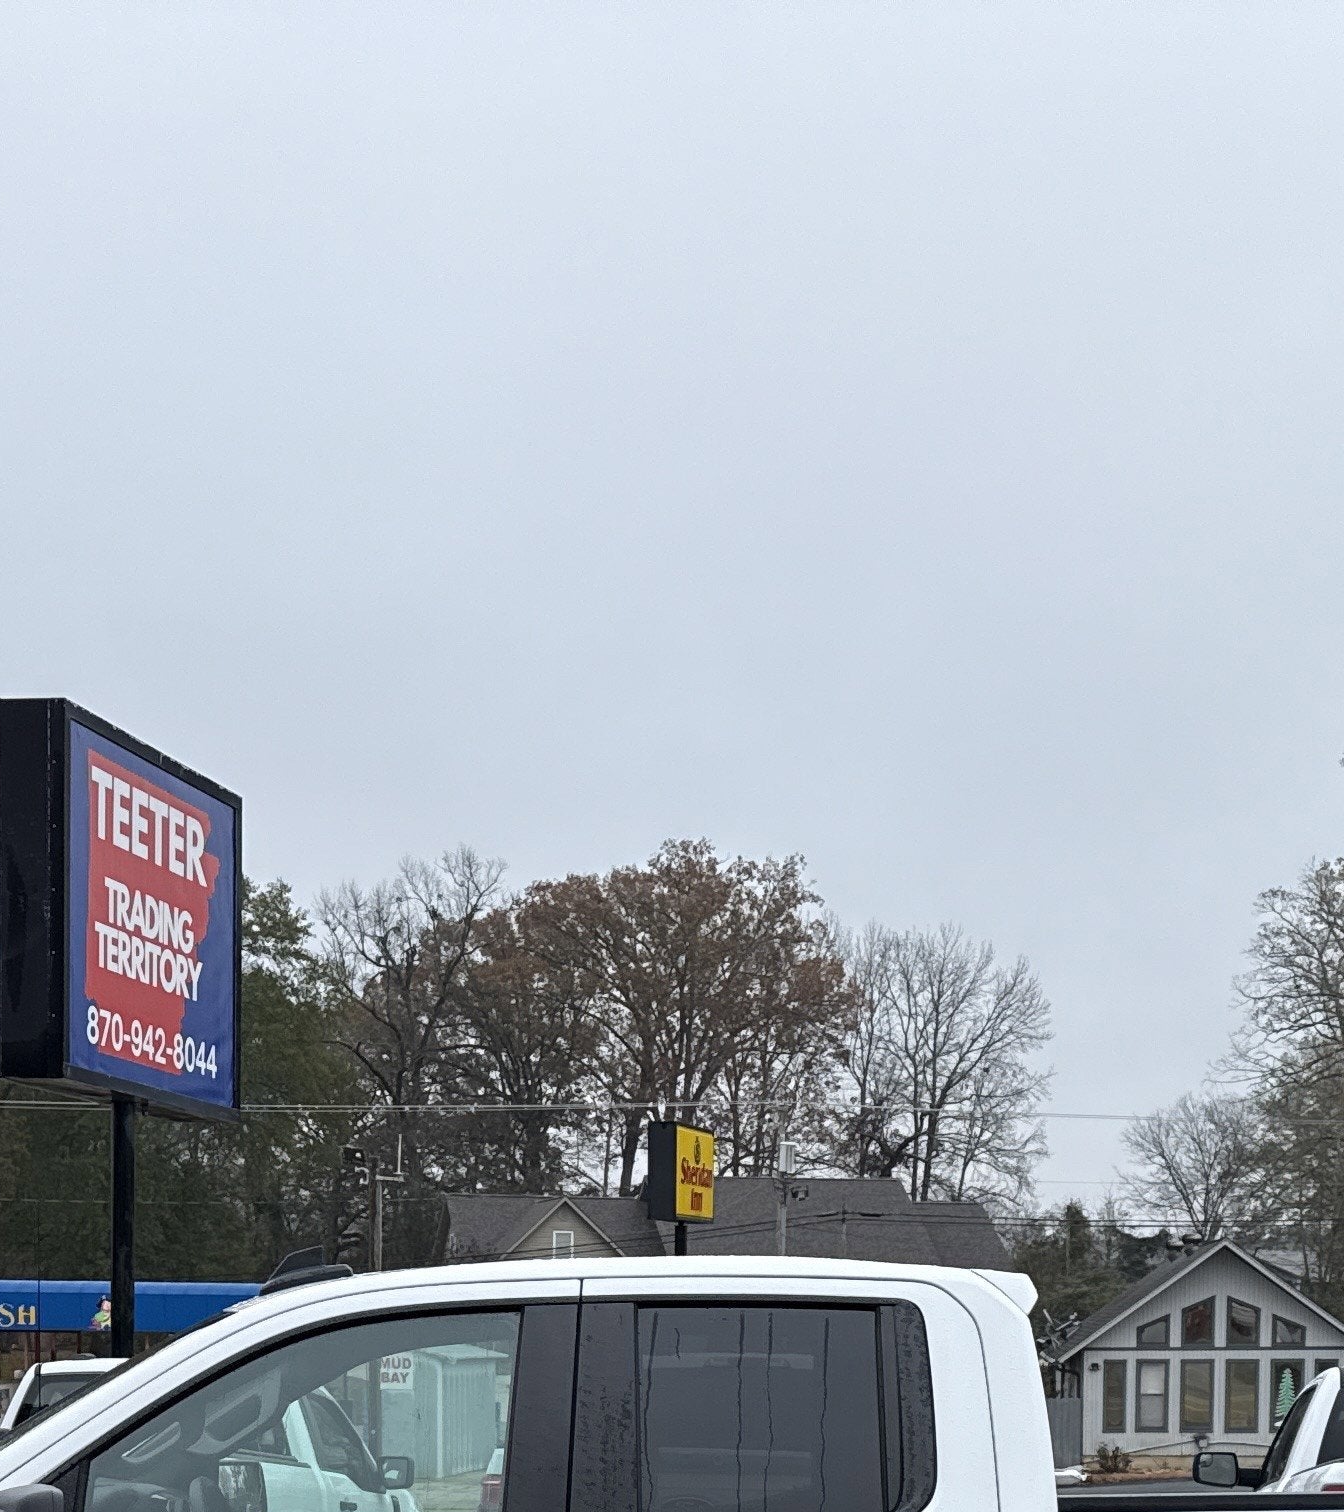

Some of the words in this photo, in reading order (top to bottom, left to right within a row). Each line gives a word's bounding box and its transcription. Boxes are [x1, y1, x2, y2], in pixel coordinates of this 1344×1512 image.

[91, 765, 208, 888] TEETER
[104, 876, 195, 954] TRADING
[94, 920, 204, 1002] TERRITORY
[86, 1005, 218, 1079] 870-942-8044
[380, 1371, 410, 1384] BAY
[381, 1357, 412, 1370] MUD
